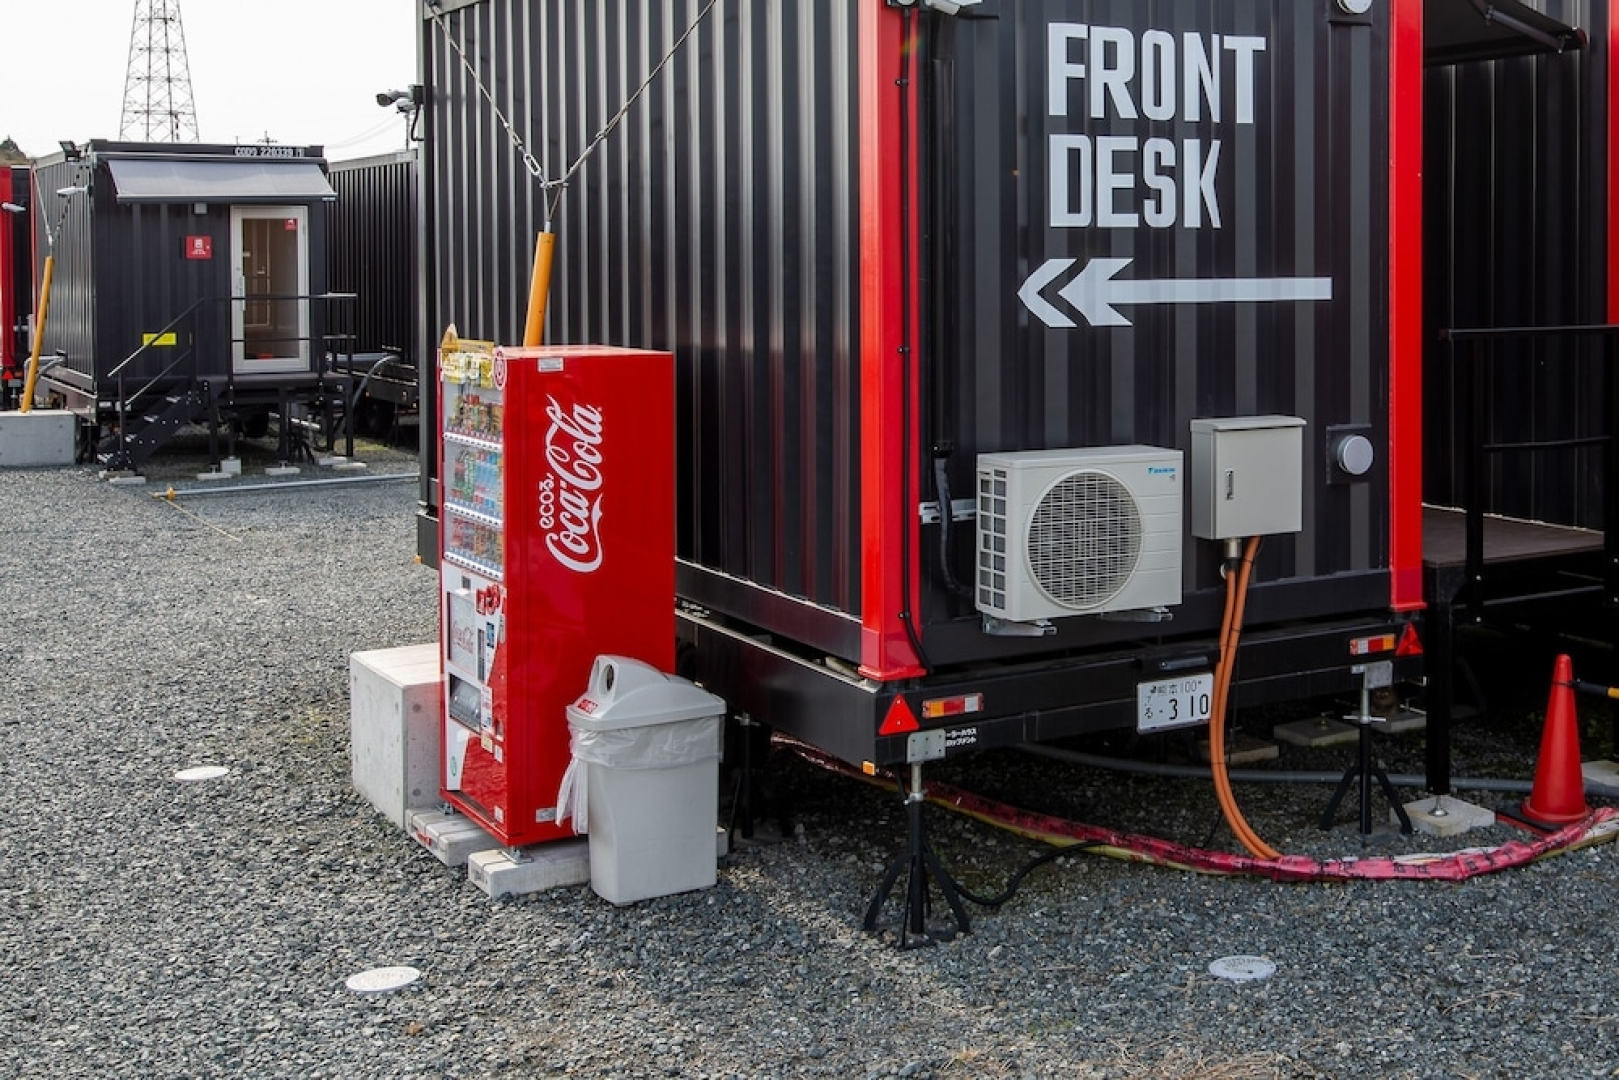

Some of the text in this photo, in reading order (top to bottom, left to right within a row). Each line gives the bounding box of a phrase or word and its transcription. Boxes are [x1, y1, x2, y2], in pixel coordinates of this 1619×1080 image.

[1048, 22, 1267, 124] FRONT
[1049, 133, 1222, 229] DESK
[545, 393, 604, 573] Coca-Cola
